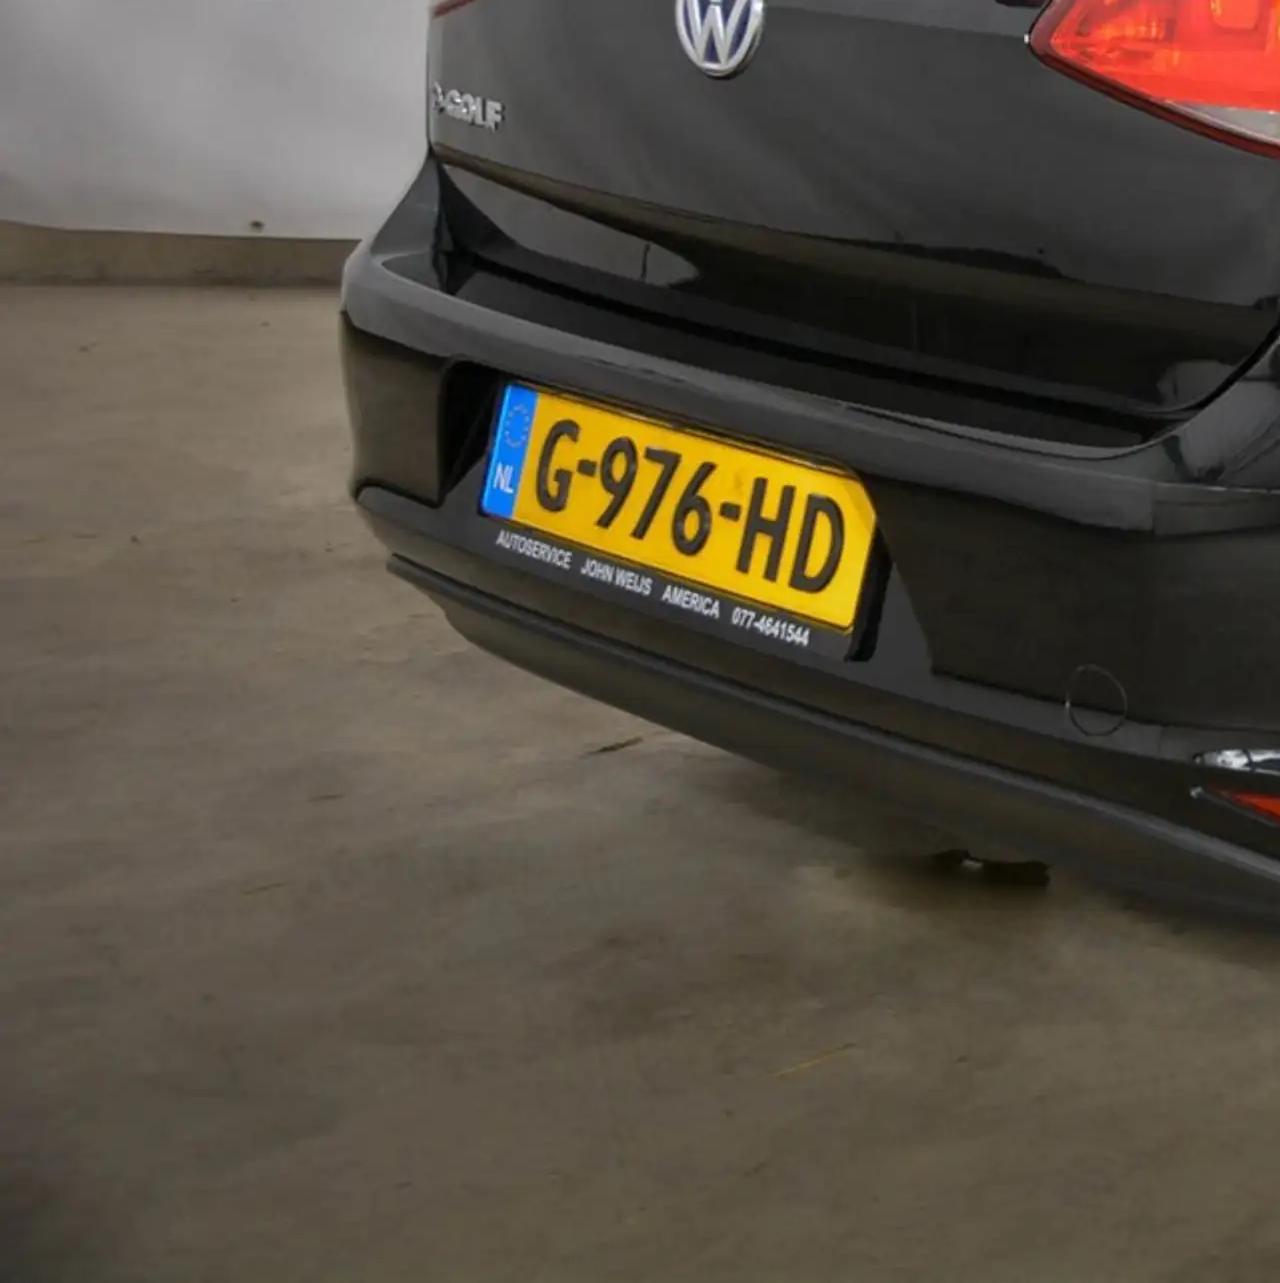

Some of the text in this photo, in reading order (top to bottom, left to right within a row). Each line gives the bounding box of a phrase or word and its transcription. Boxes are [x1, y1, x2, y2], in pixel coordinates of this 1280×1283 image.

[493, 460, 514, 495] NL
[535, 419, 845, 594] G-976-HD
[495, 529, 811, 648] AUTOSERVICE JOHN WEIJS AMERICA 077-4641544
